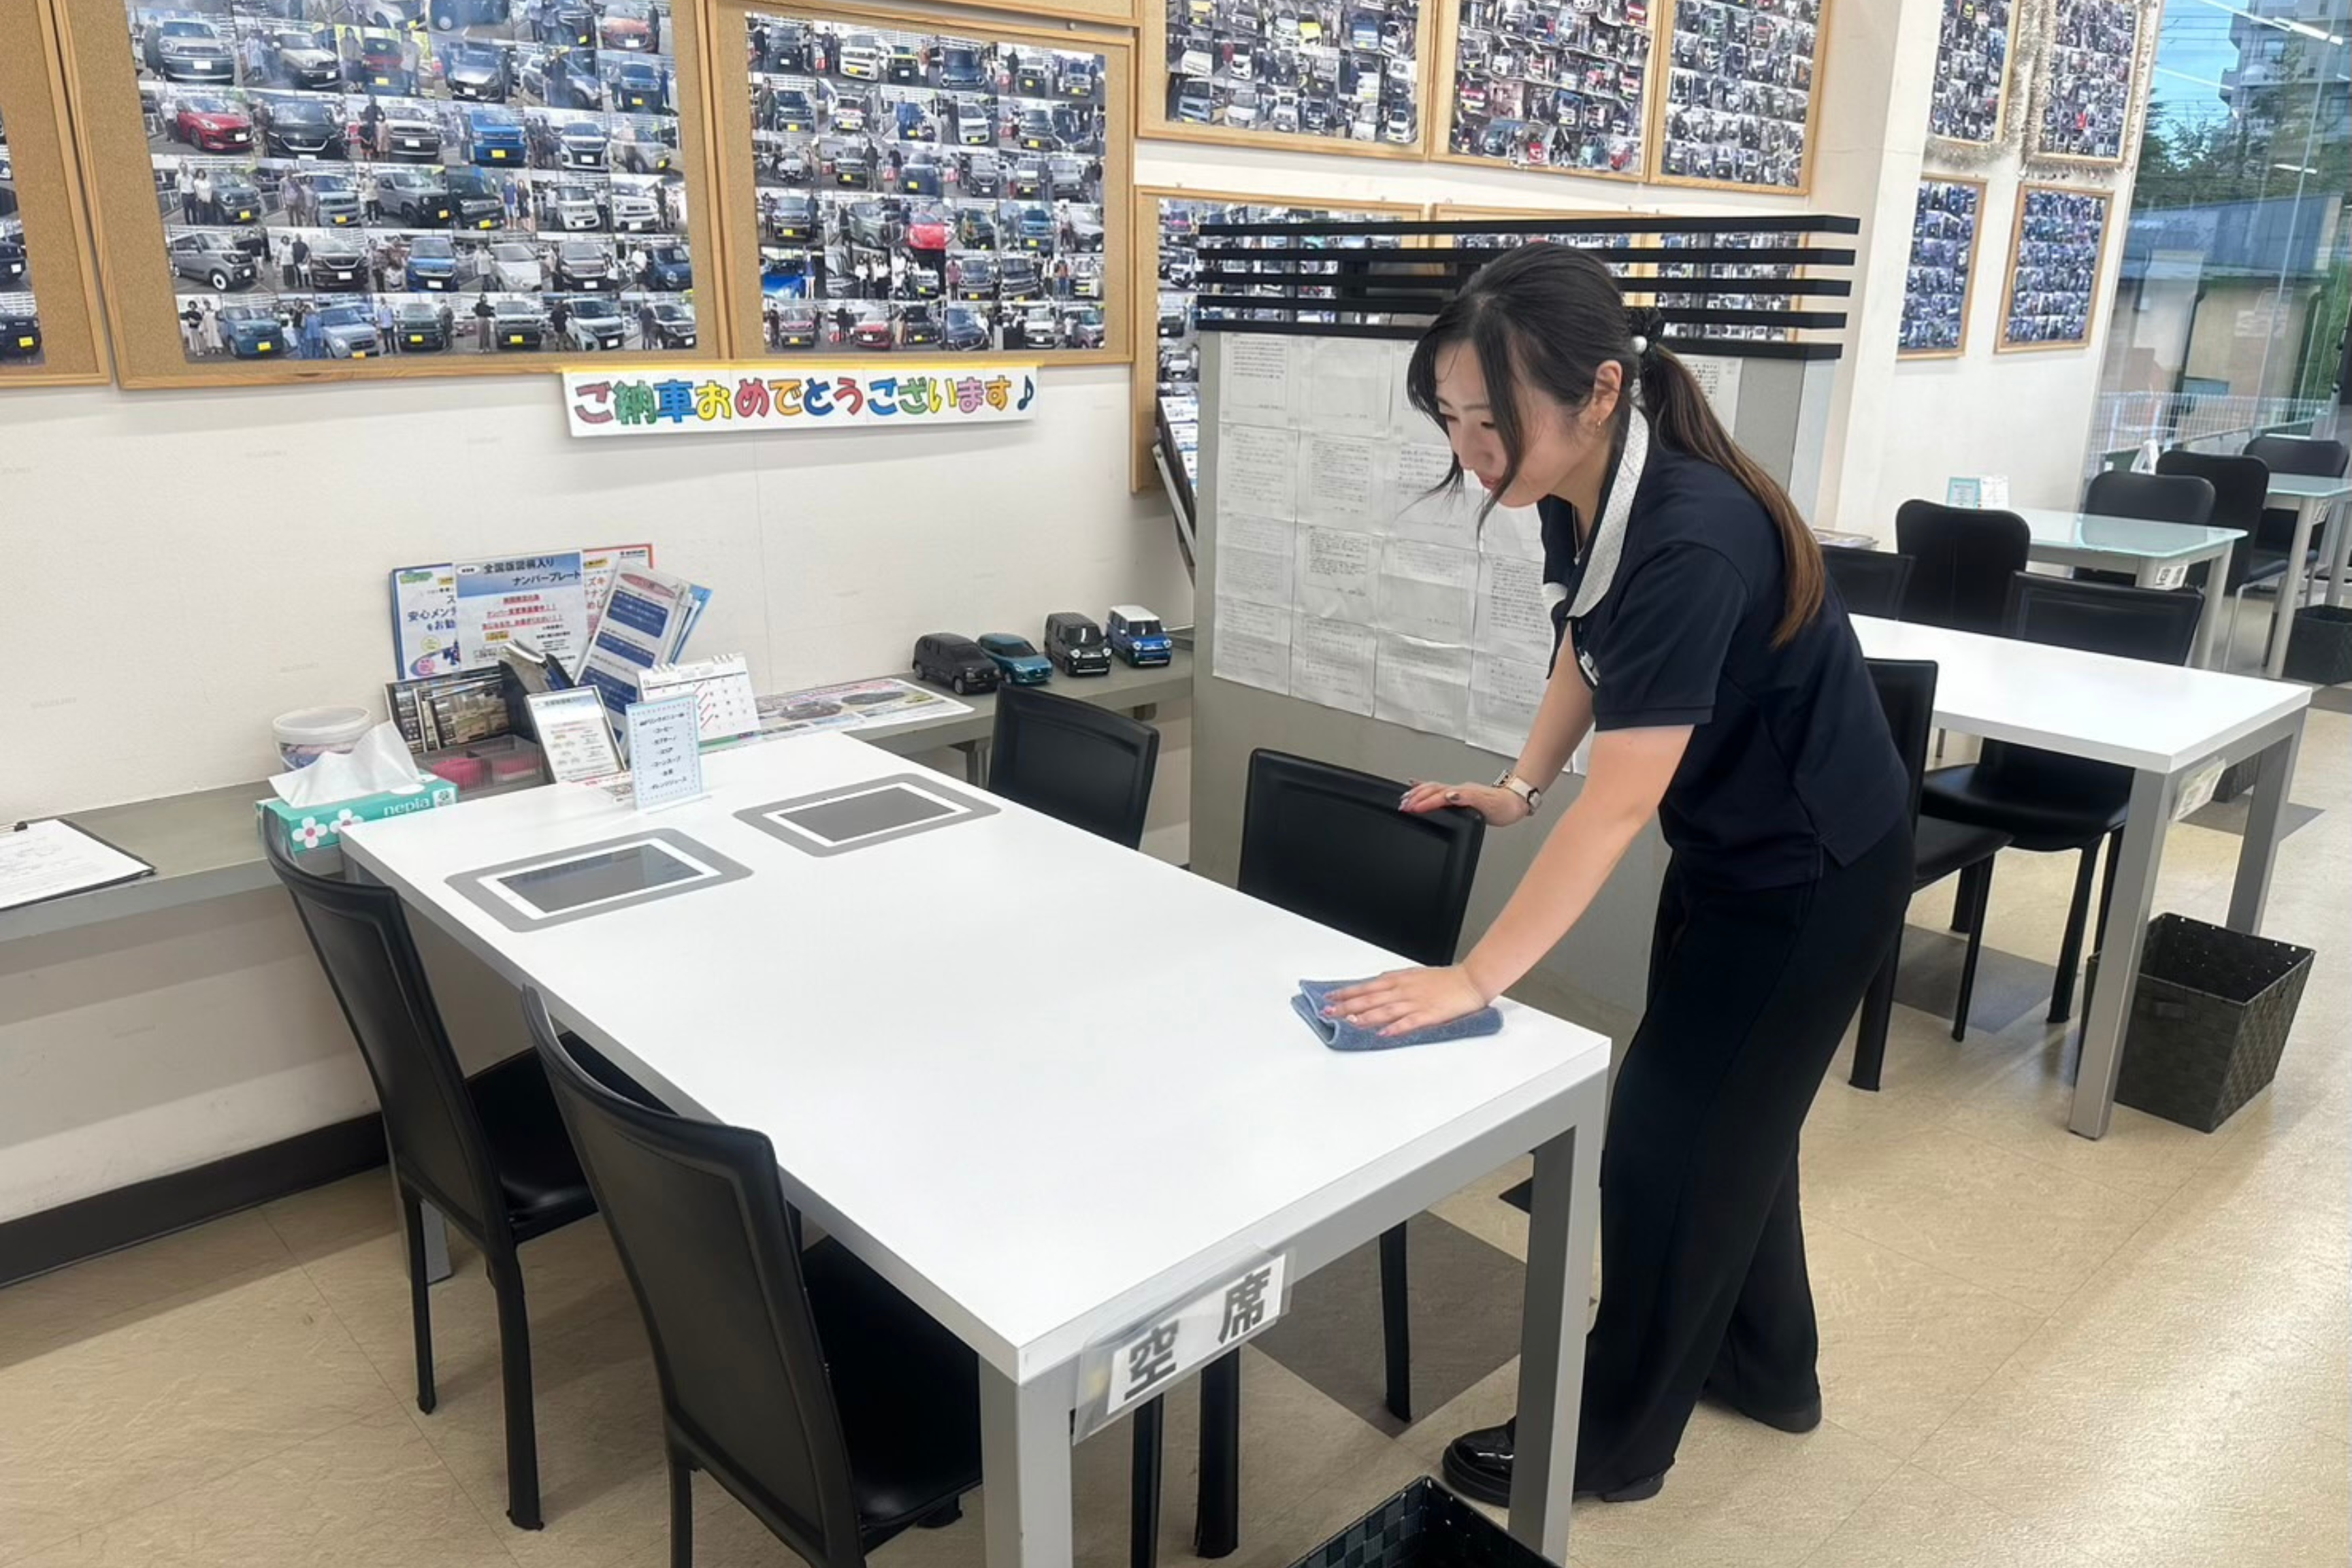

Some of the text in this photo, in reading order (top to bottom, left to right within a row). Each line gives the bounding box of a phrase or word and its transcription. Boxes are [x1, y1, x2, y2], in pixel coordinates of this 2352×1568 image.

[575, 376, 1011, 425] ご納車おめでとうございます
[512, 570, 581, 587] ナンバープレート
[384, 798, 430, 816] nepia
[1124, 1267, 1272, 1402] 空席
